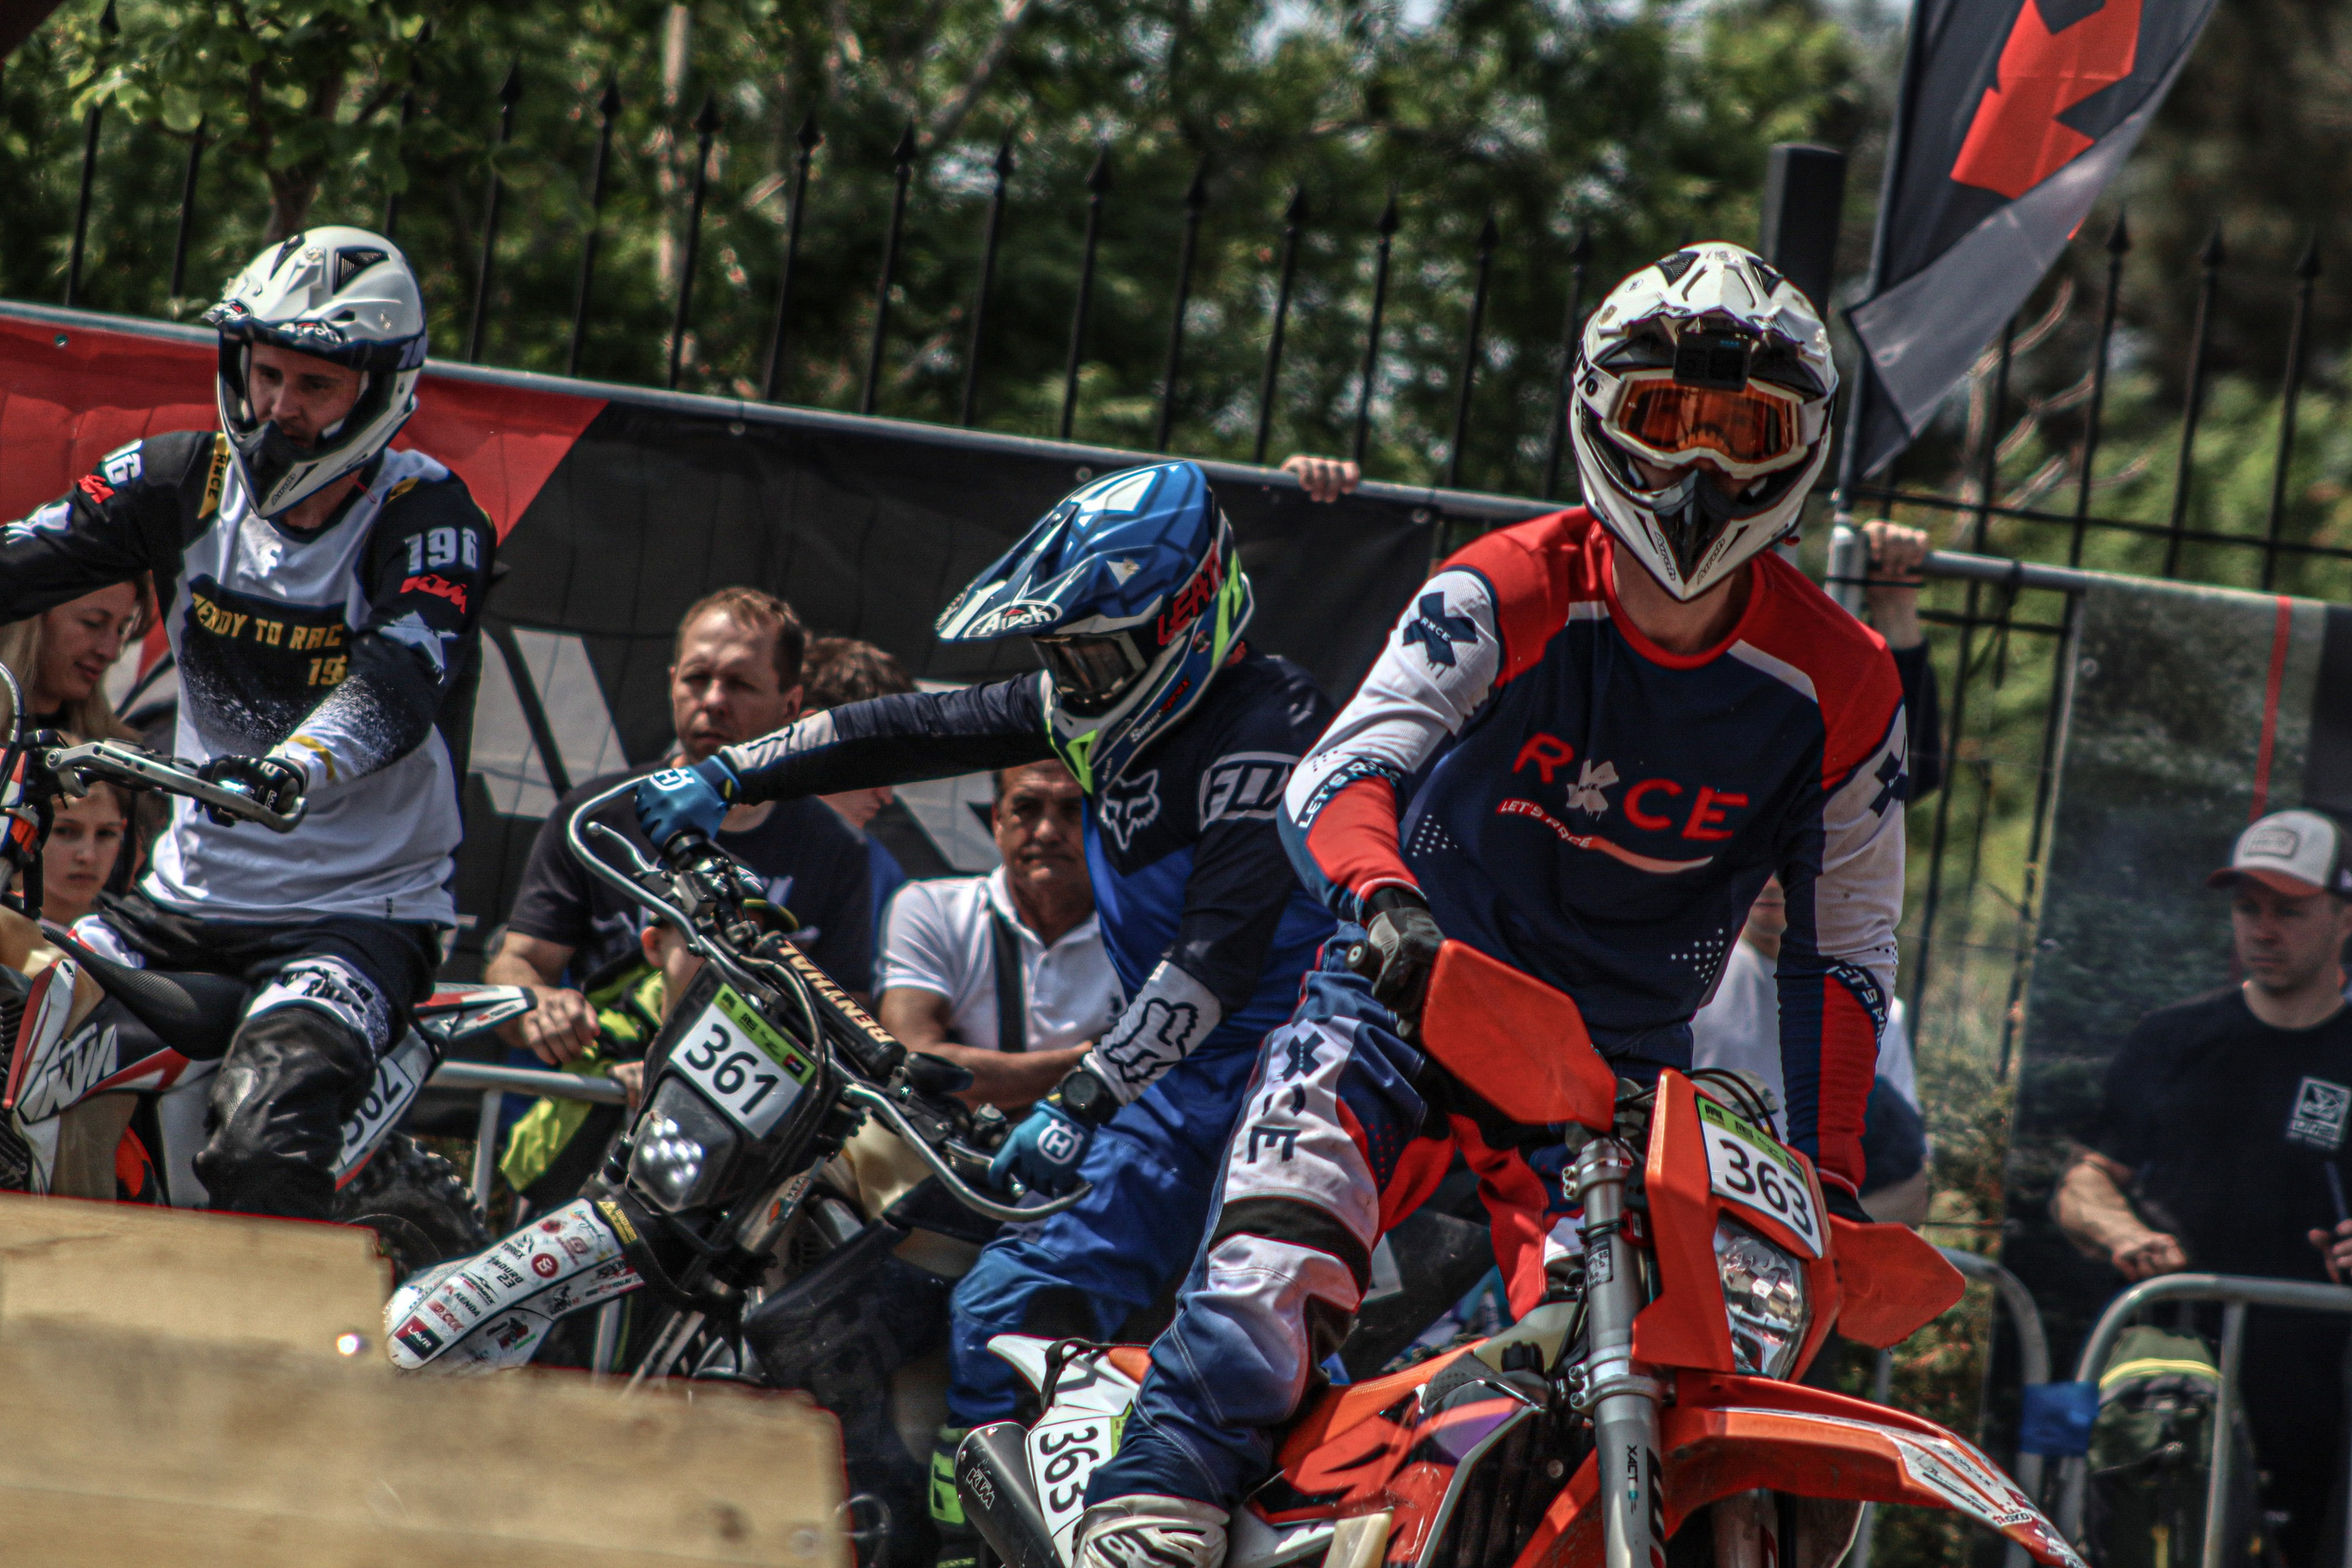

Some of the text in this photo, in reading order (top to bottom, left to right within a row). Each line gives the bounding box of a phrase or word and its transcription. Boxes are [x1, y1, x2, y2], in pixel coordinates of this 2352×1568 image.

[404, 526, 477, 574] 196
[400, 573, 467, 615] KTM
[255, 617, 284, 646] TO
[289, 624, 345, 650] RAC
[978, 604, 1052, 635] Airoh
[1298, 773, 1349, 829] LET'S
[1500, 800, 1544, 818] LET'S
[778, 940, 896, 1044] RENTHAL
[18, 1022, 118, 1122] KTM
[684, 1023, 779, 1115] 361
[1718, 1137, 1814, 1239] 363
[496, 1273, 517, 1289] 23
[454, 1292, 481, 1317] KENDA
[407, 1325, 433, 1350] LAVR
[1627, 1444, 1638, 1483] XACT
[966, 1467, 995, 1510] KTM
